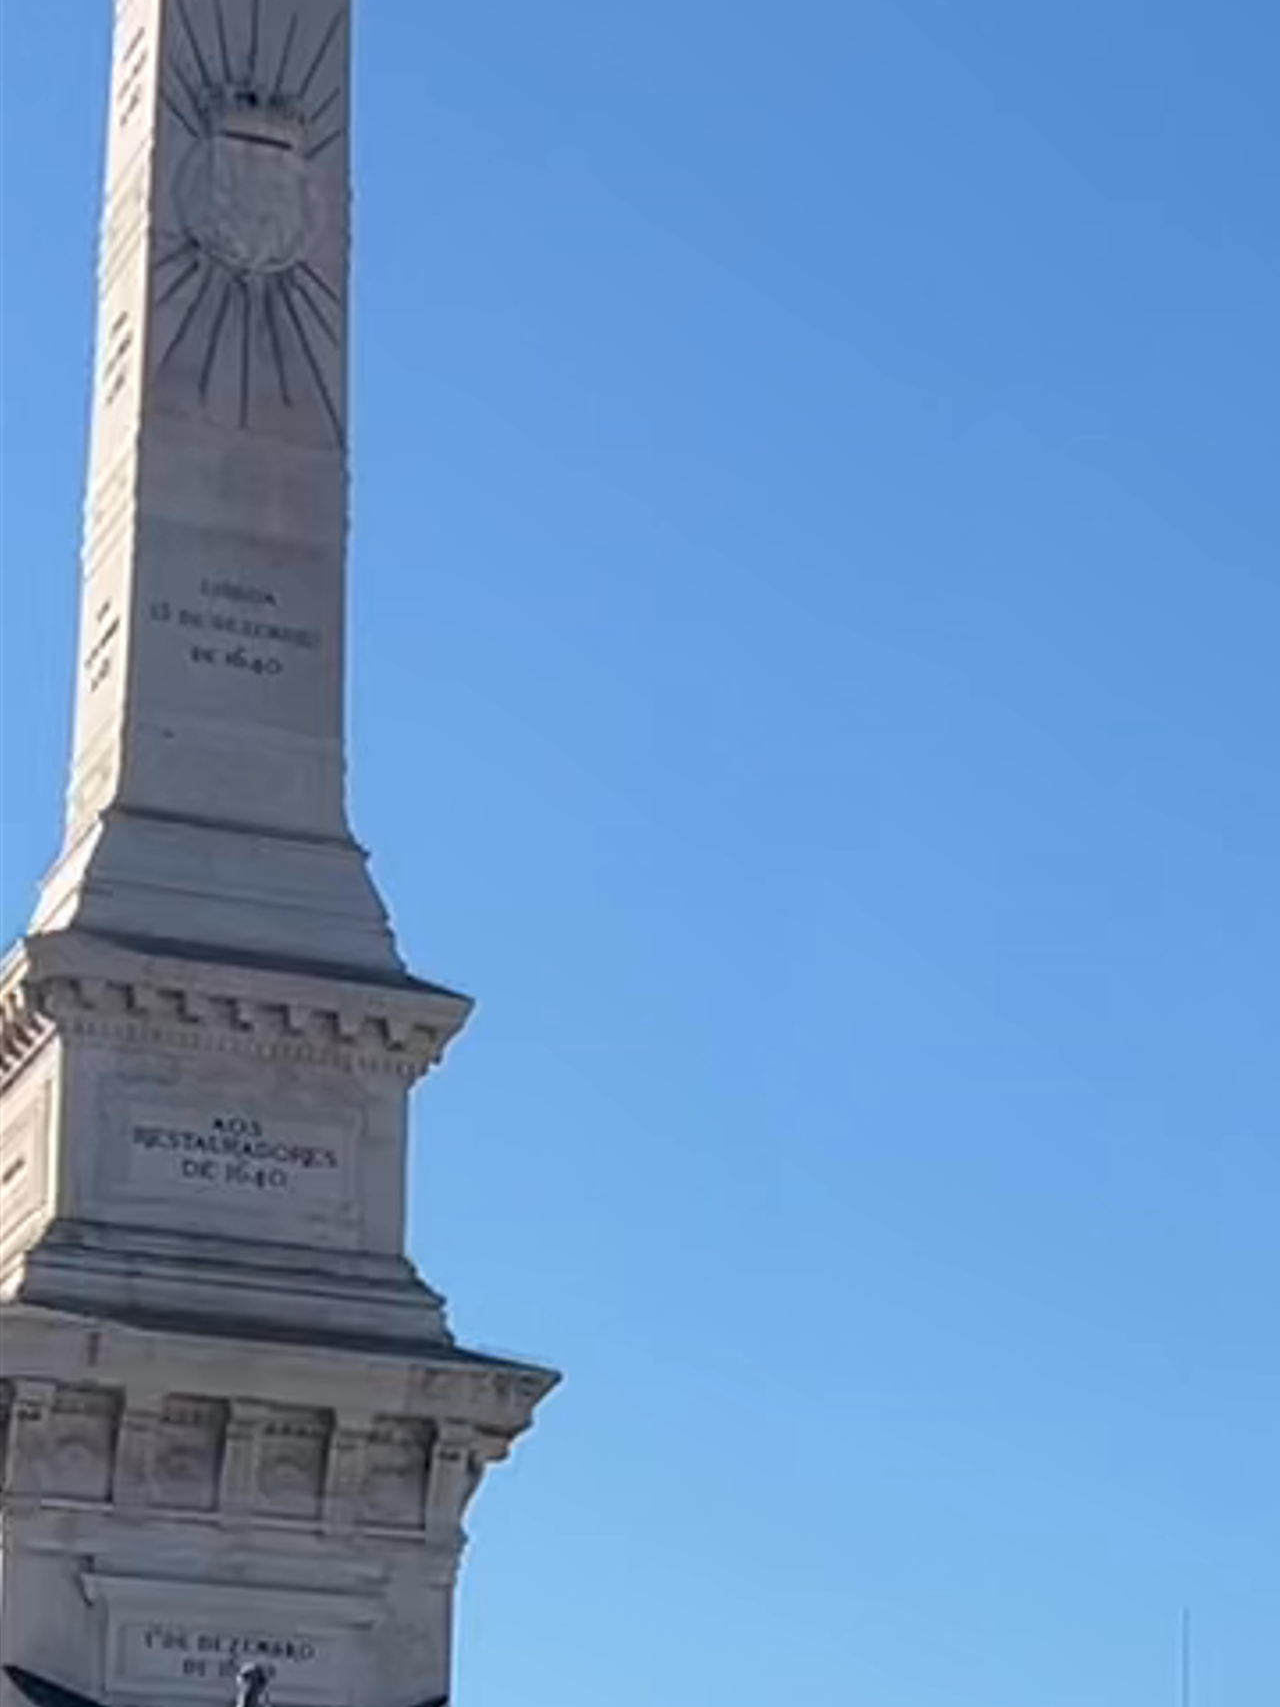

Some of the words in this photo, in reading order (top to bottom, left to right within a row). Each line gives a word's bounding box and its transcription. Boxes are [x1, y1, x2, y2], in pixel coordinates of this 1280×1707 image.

[213, 1116, 263, 1138] AOS
[133, 1125, 338, 1169] RESTAURADORES
[182, 1158, 219, 1180] DE
